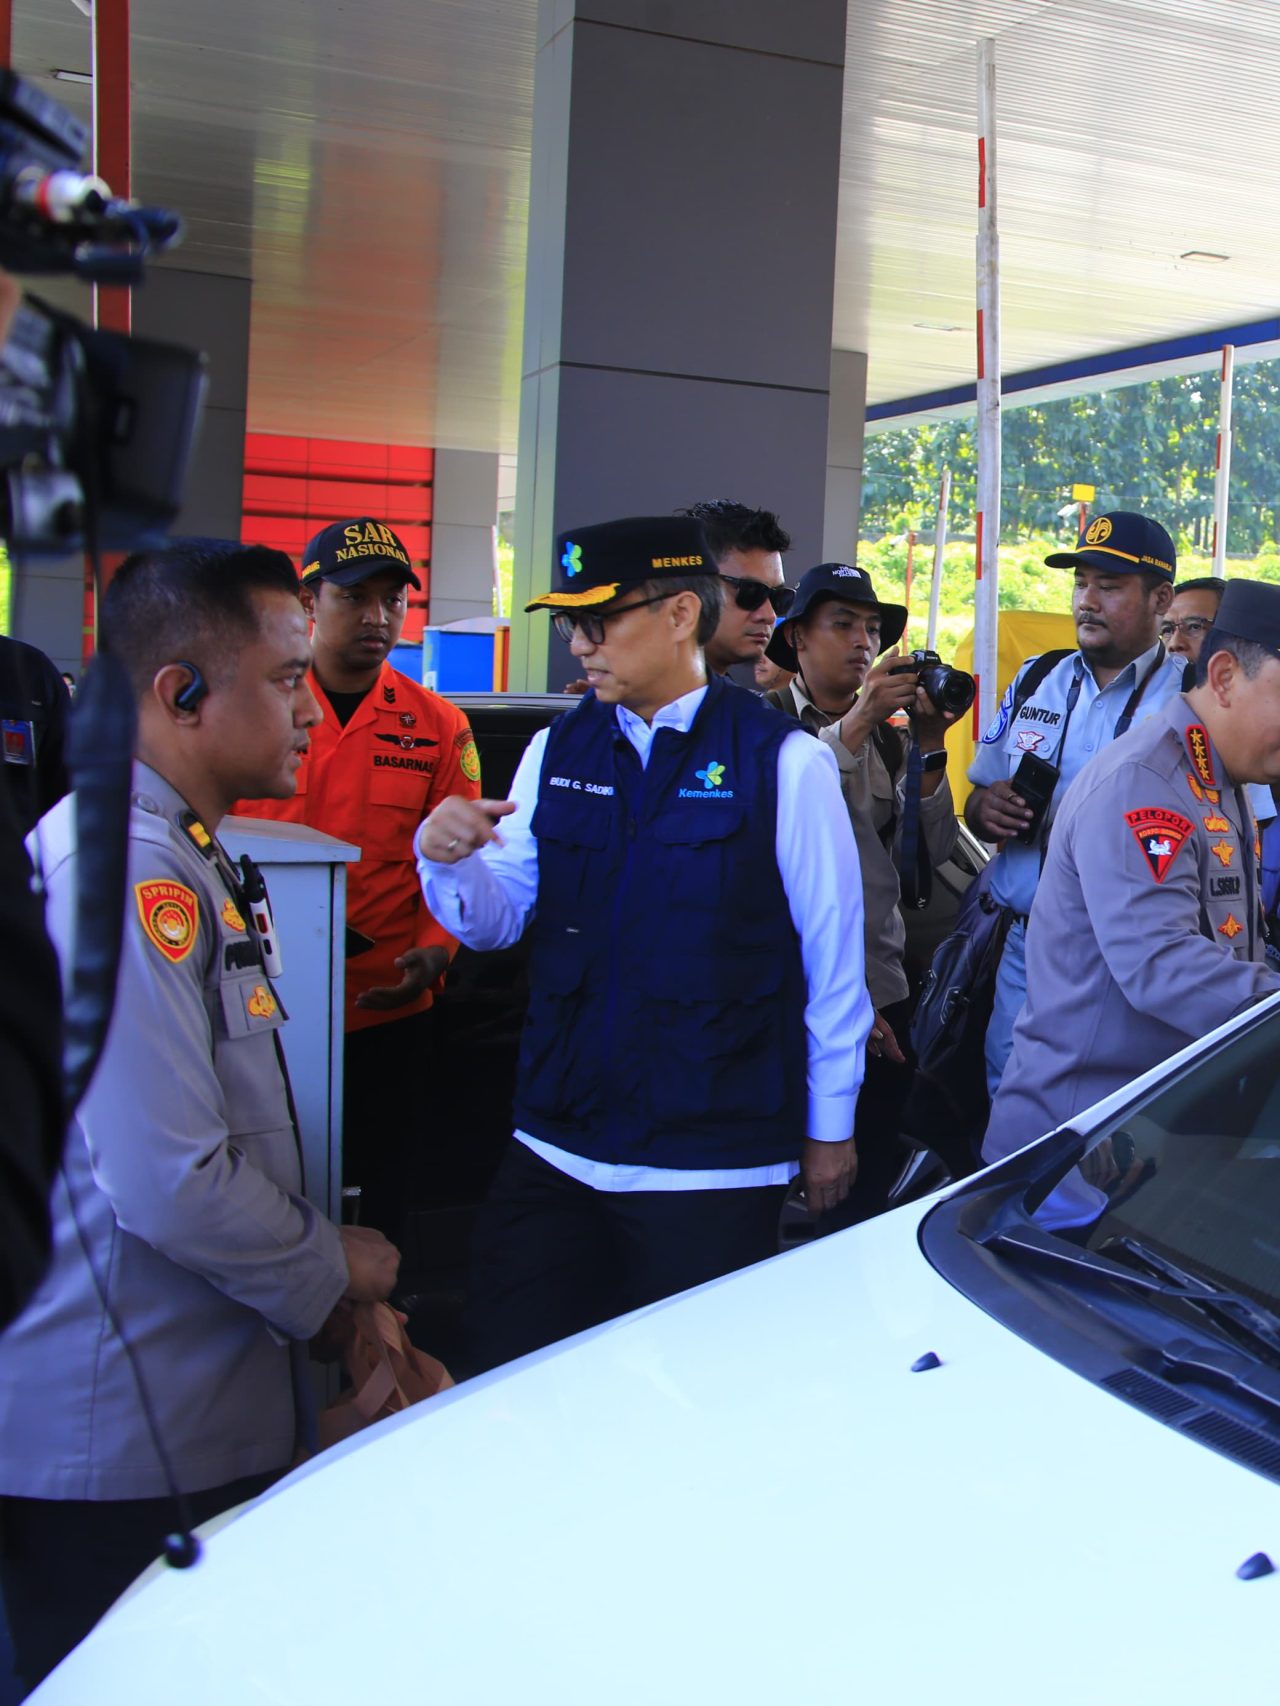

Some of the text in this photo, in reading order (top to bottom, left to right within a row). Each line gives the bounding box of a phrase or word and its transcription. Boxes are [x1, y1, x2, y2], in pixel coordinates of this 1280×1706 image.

[344, 522, 397, 547] SAR
[335, 543, 410, 566] NASIONAL
[651, 555, 703, 569] MENKES
[1019, 705, 1061, 726] GUNTUR
[549, 776, 571, 788] BUDI
[571, 780, 582, 790] G.
[678, 788, 734, 799] Kemenkes
[1128, 810, 1191, 832] PELOPOR
[142, 884, 194, 906] SPRIPIM
